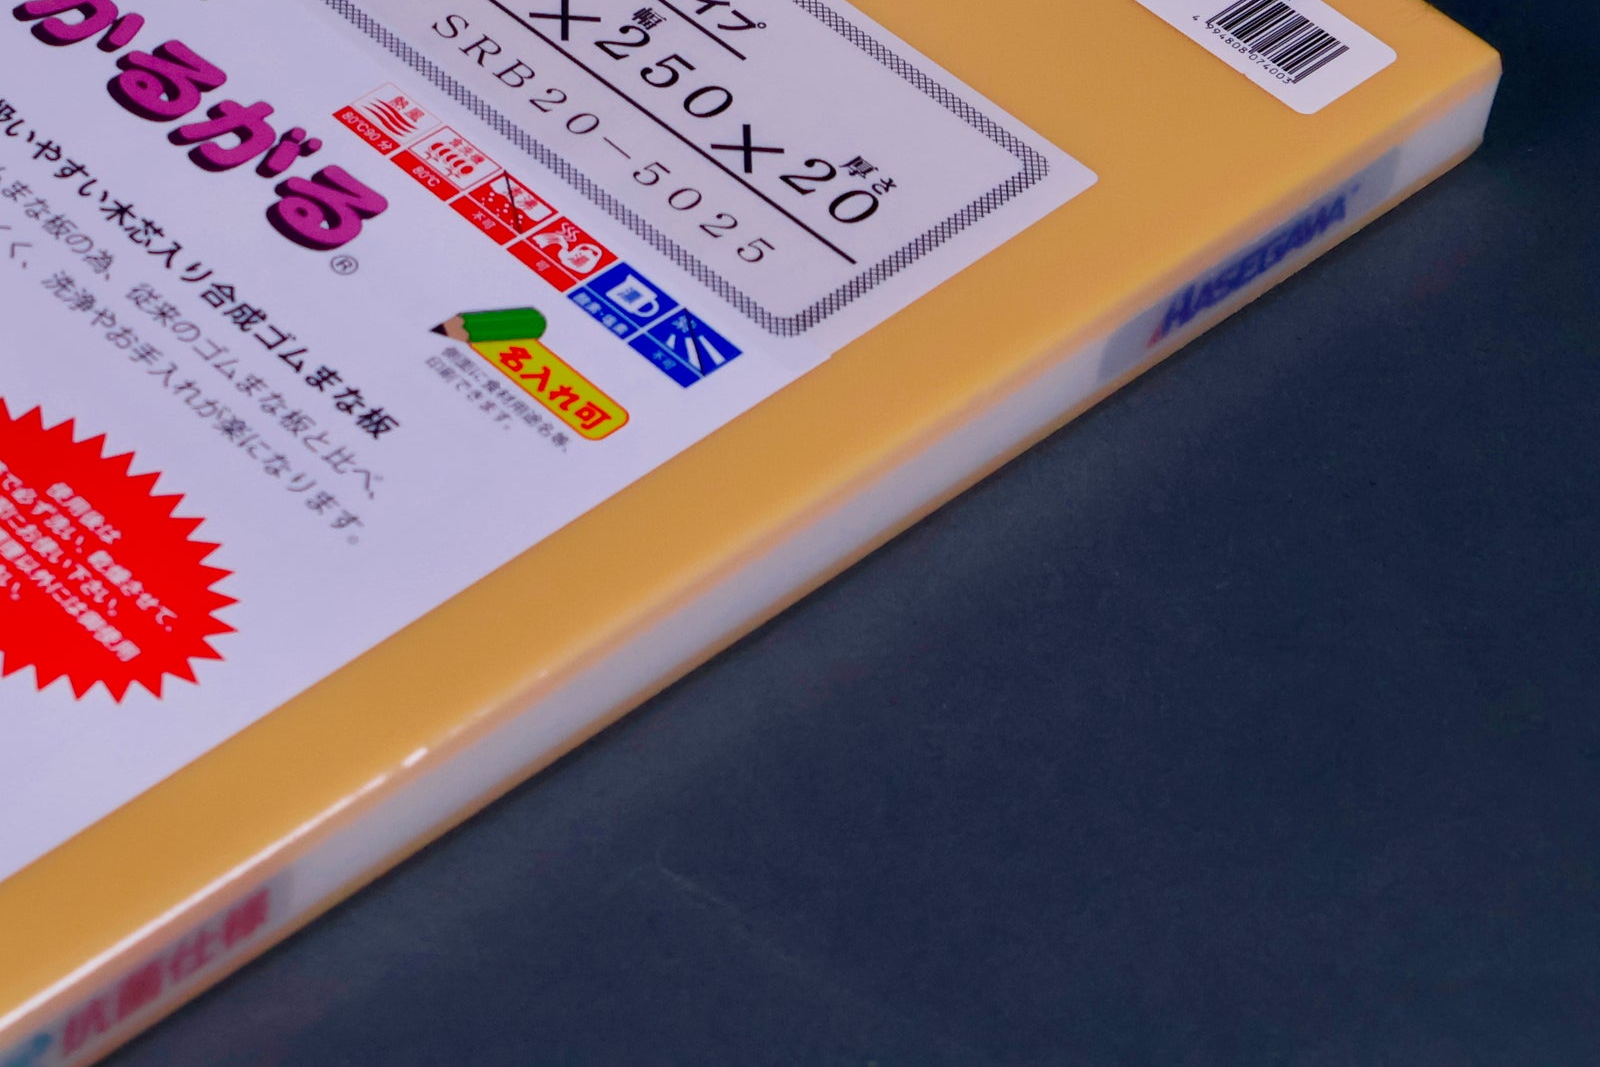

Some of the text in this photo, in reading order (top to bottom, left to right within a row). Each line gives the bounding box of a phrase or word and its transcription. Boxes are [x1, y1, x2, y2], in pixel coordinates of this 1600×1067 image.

[631, 5, 667, 32] 幅
[840, 154, 898, 193] 厚さ
[499, 339, 612, 430] 名入れ可
